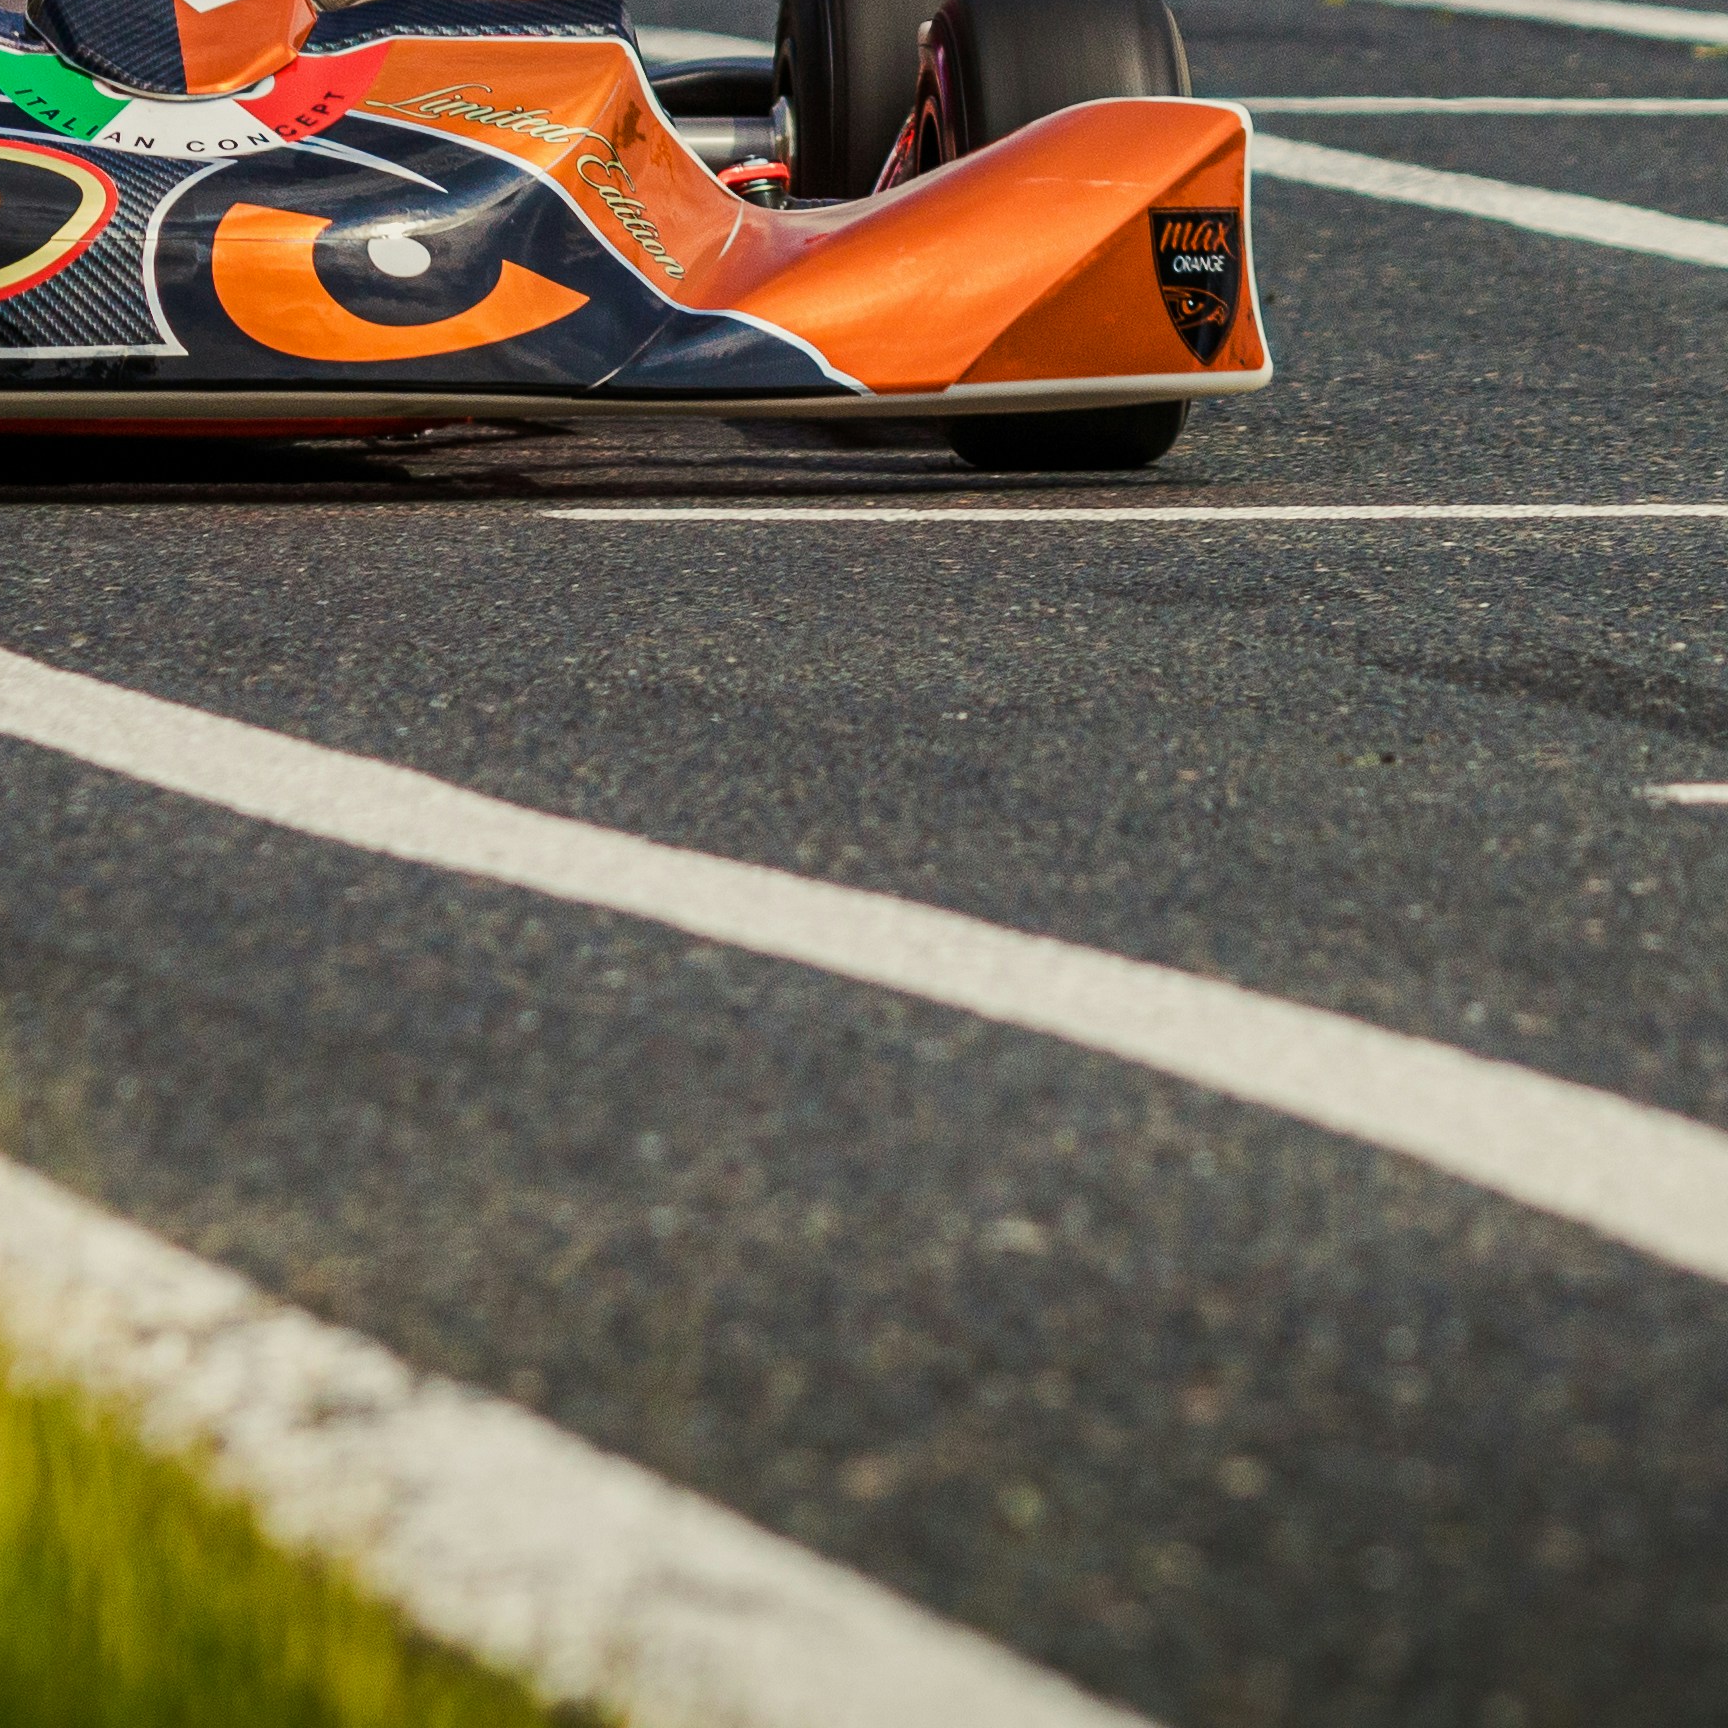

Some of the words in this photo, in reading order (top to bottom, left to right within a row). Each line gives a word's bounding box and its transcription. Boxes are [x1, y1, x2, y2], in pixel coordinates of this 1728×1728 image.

[15, 88, 155, 149] ITALIAN
[186, 90, 345, 152] CONCEPT
[365, 83, 592, 144] Limited
[576, 140, 686, 280] Edition
[1173, 255, 1225, 273] ORANGE
